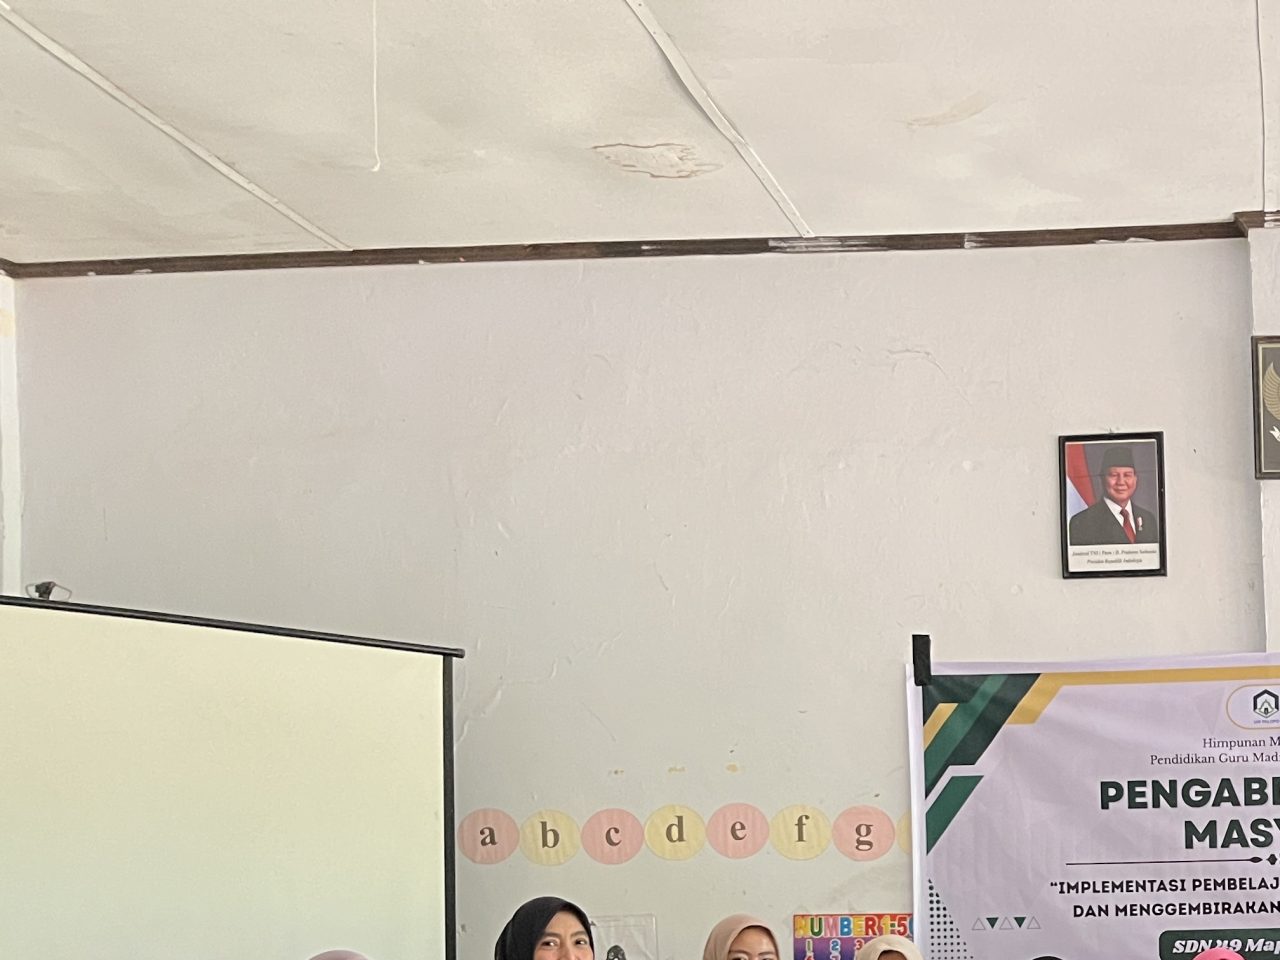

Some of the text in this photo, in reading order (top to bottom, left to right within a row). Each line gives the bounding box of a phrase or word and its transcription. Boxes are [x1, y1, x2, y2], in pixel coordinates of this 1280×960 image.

[1202, 737, 1266, 750] Himpunan
[1150, 754, 1215, 765] Pendidikan
[1218, 753, 1249, 763] Guru
[479, 825, 498, 847] a
[540, 821, 561, 848] b
[605, 826, 622, 847] c
[665, 815, 685, 843] d
[730, 820, 747, 842] e
[794, 814, 810, 843] f
[855, 821, 874, 850] g
[1073, 905, 1109, 918] DAN
[794, 915, 878, 938] NUMBER
[831, 940, 840, 951] 2
[1172, 939, 1212, 953] SDN
